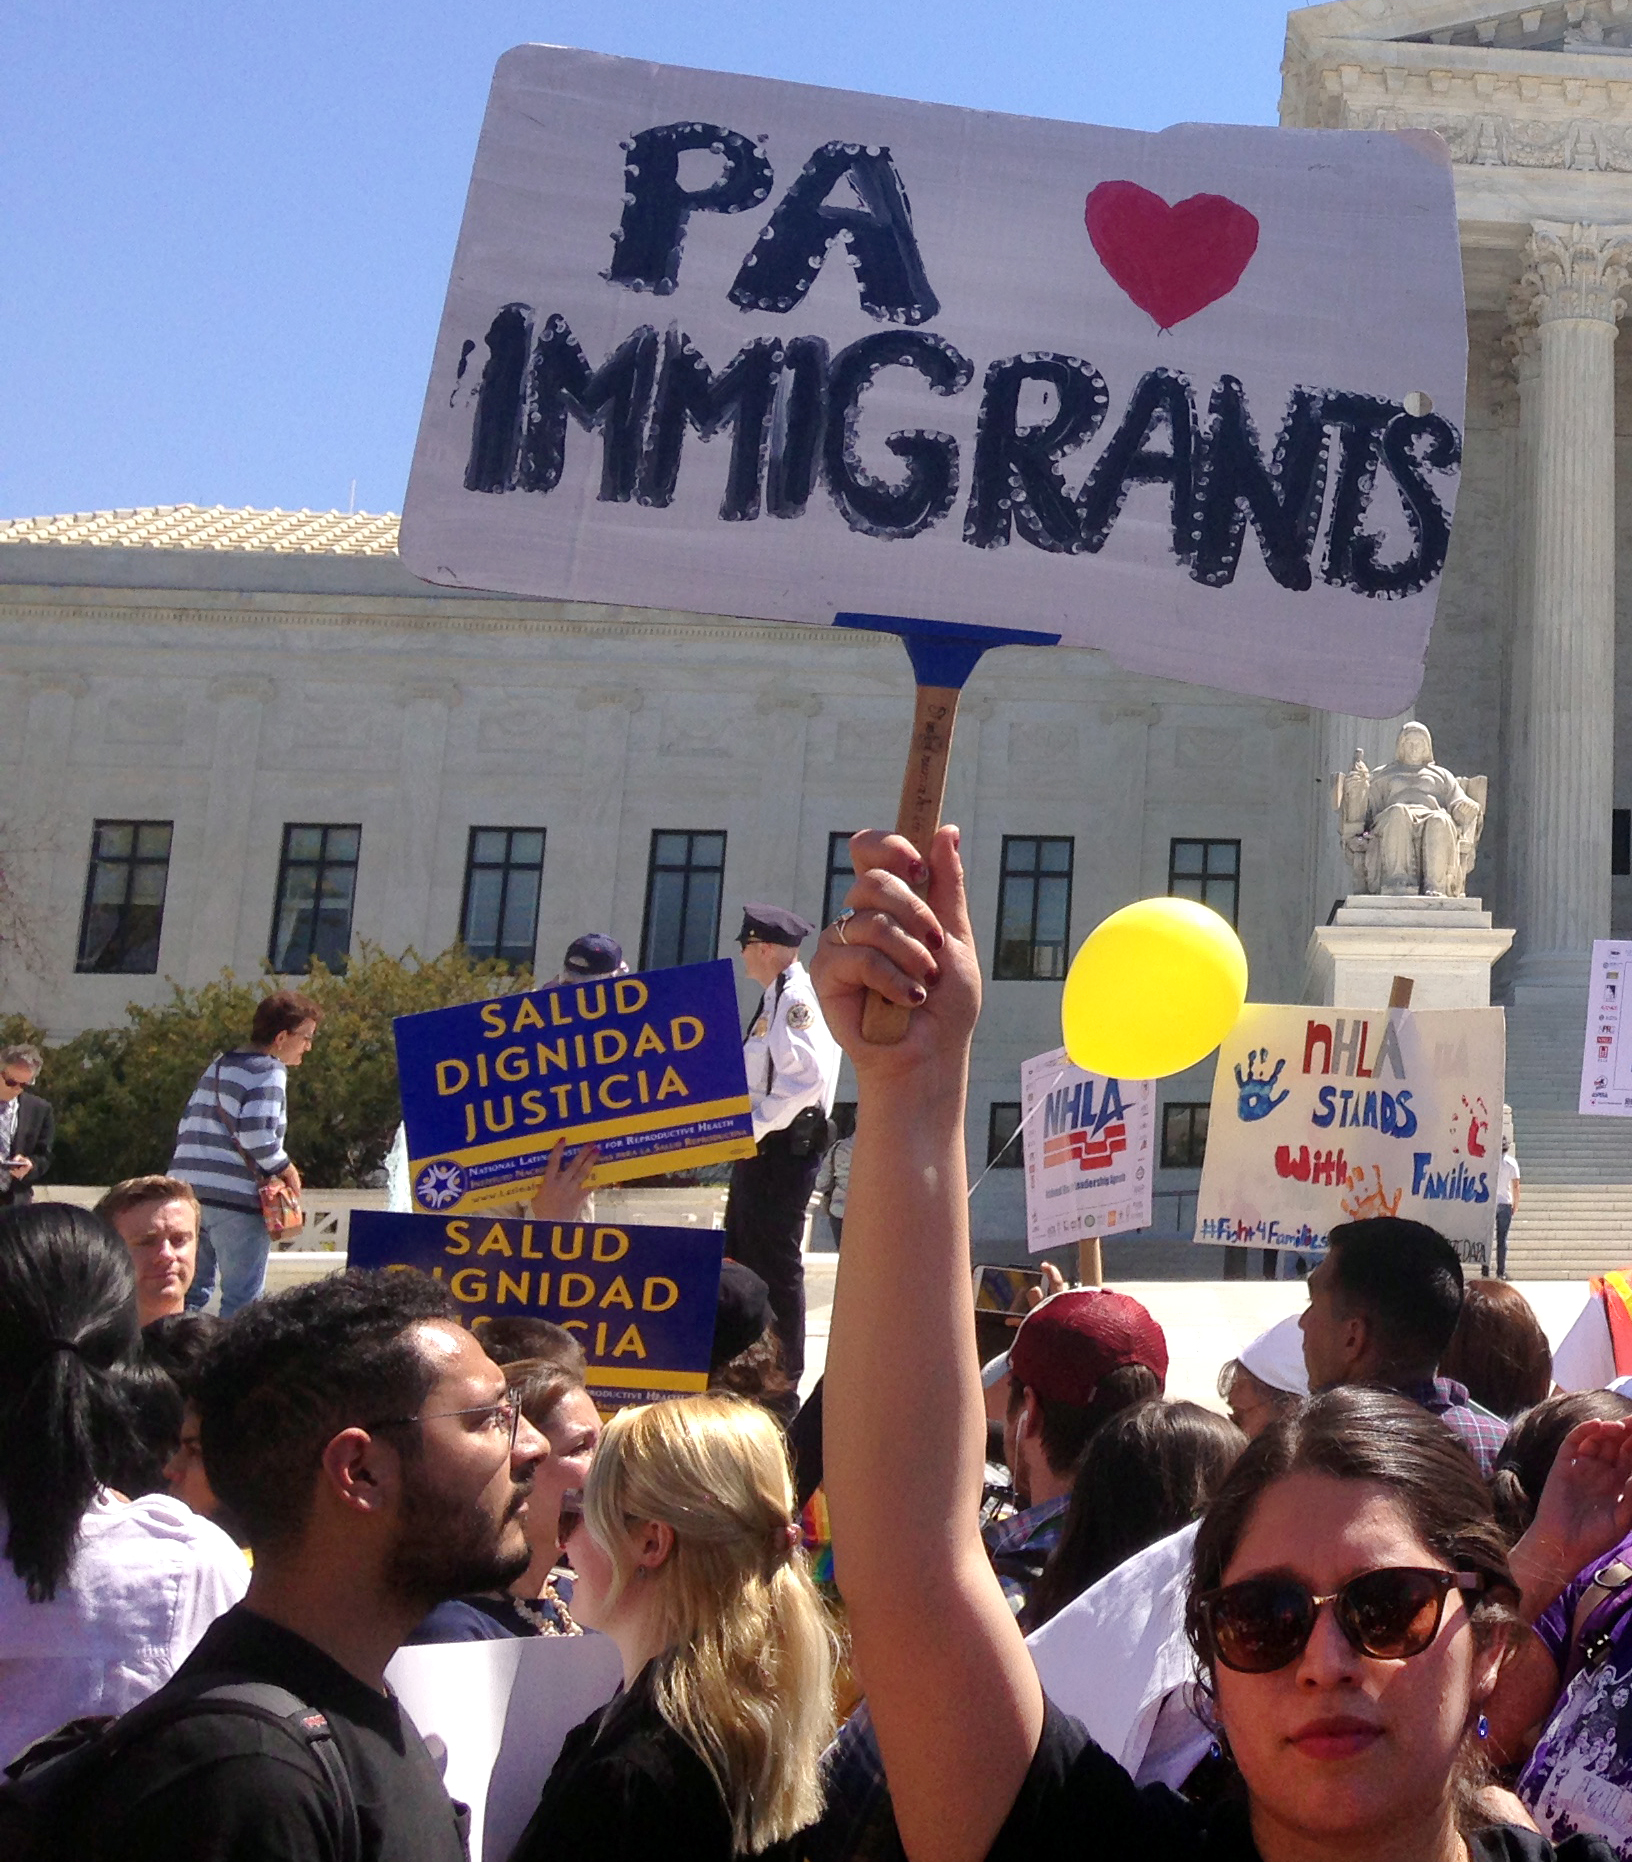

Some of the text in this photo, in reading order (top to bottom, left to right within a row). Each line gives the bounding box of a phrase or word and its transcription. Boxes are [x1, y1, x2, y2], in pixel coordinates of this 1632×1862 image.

[599, 121, 941, 326] PA
[461, 301, 1463, 600] IMMIGRANTS
[480, 979, 649, 1038] SALUD
[435, 1016, 705, 1096] DIGNIDAD
[465, 1065, 689, 1142] JUSTICIA
[1043, 1078, 1136, 1139] NHLA
[1312, 1086, 1417, 1138] STANDS
[605, 1139, 623, 1150] FOR
[626, 1127, 694, 1146] REPRODUCTIVE
[698, 1119, 734, 1133] HEALTH
[469, 1162, 515, 1177] NATIONAL
[520, 1154, 549, 1167] LATIN
[1275, 1145, 1347, 1186] With
[445, 1220, 629, 1263] SALUD
[385, 1264, 679, 1312] GNIDAD
[587, 1390, 643, 1400] RODUCTIVE
